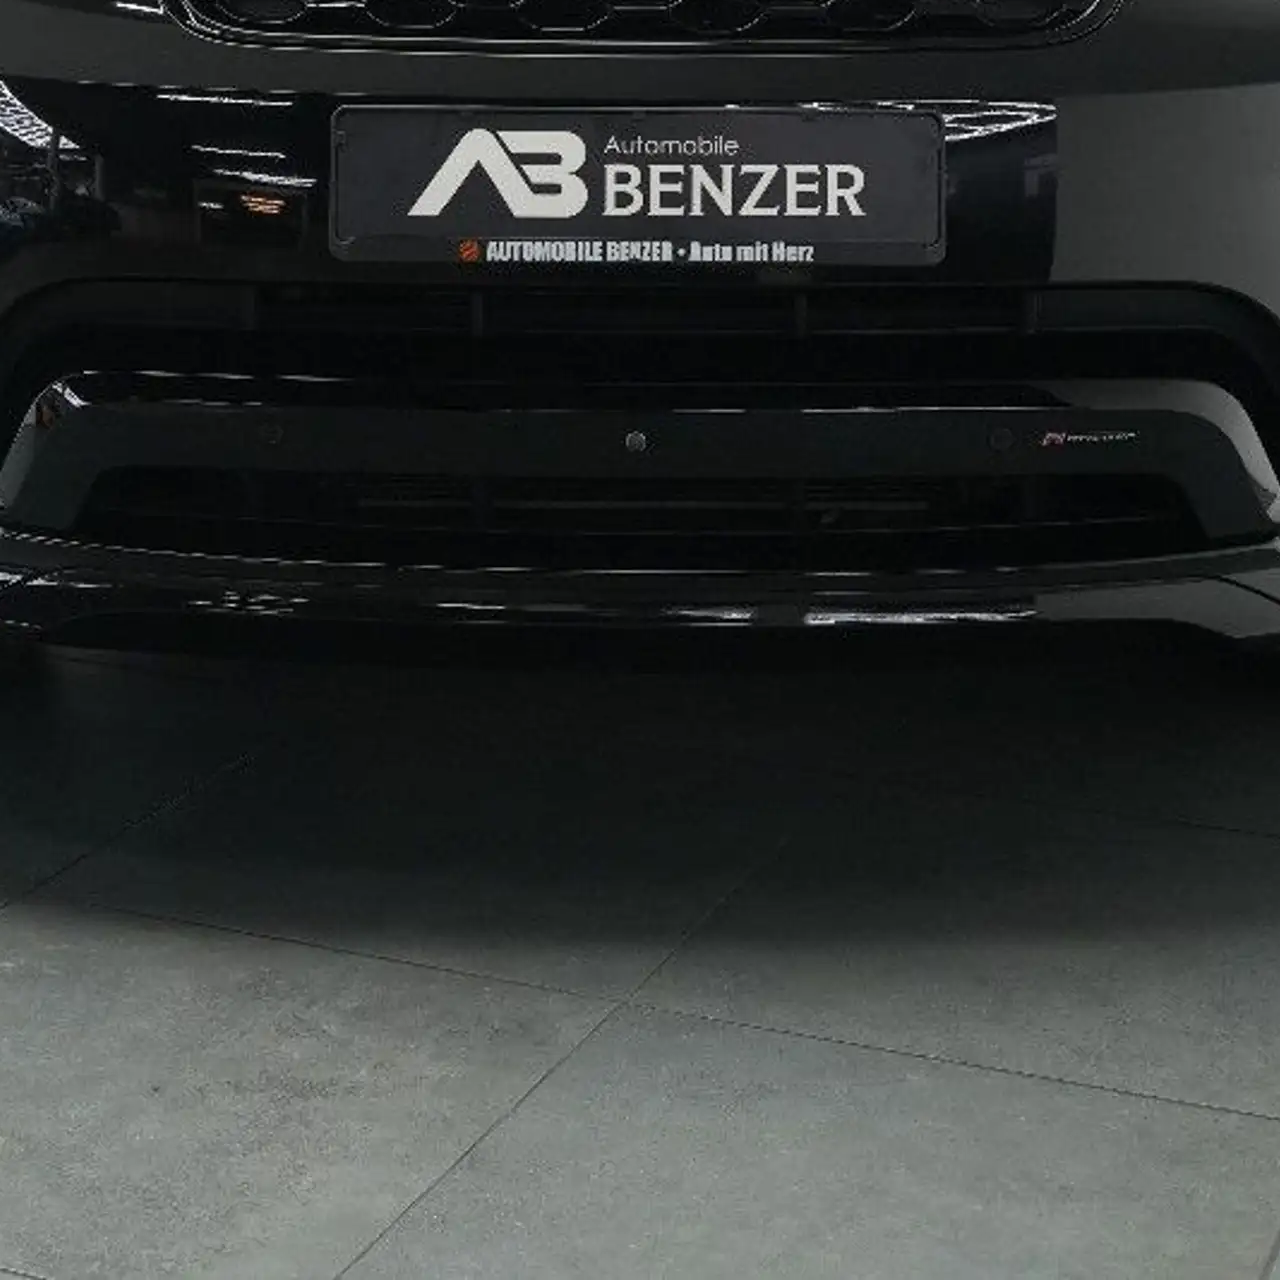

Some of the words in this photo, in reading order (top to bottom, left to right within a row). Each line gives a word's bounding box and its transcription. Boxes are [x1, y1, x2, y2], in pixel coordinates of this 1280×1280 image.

[603, 135, 740, 157] Automobile
[602, 163, 867, 217] BENZER
[486, 240, 603, 262] AUTOMOBILE
[606, 240, 673, 262] BENZER
[688, 240, 733, 262] Auto
[736, 241, 769, 262] mit
[771, 241, 814, 262] Herz
